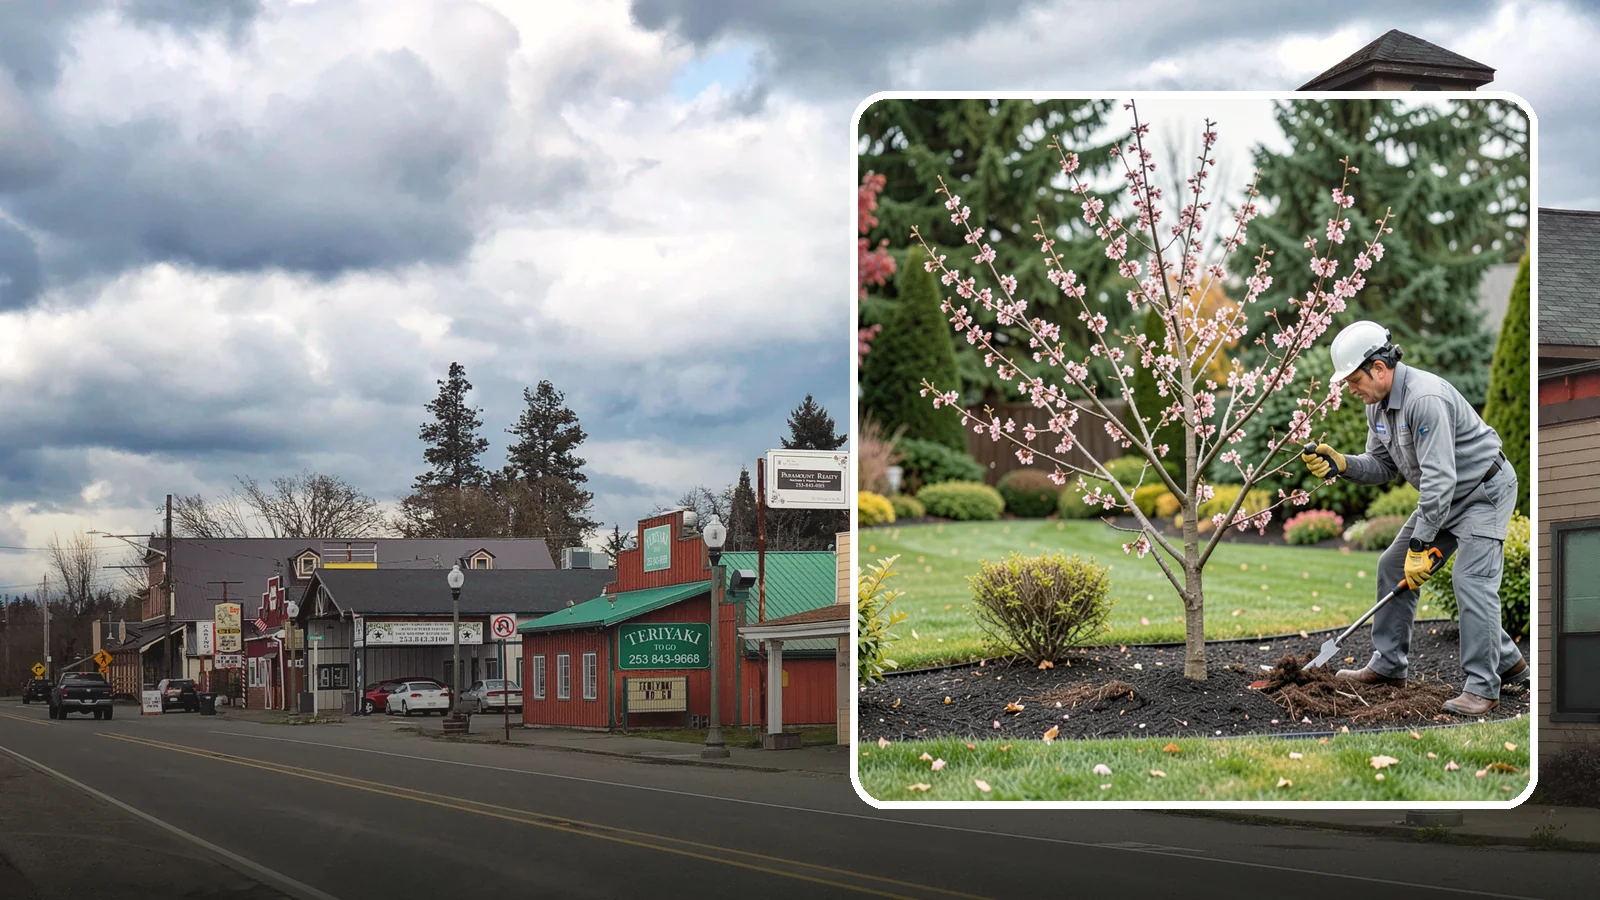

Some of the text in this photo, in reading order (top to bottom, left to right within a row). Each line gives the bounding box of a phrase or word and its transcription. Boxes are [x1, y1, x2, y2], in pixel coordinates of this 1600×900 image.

[781, 471, 814, 479] PARAMOUNT
[625, 628, 702, 646] TERIYAKI
[629, 654, 700, 664] 253 843-9668
